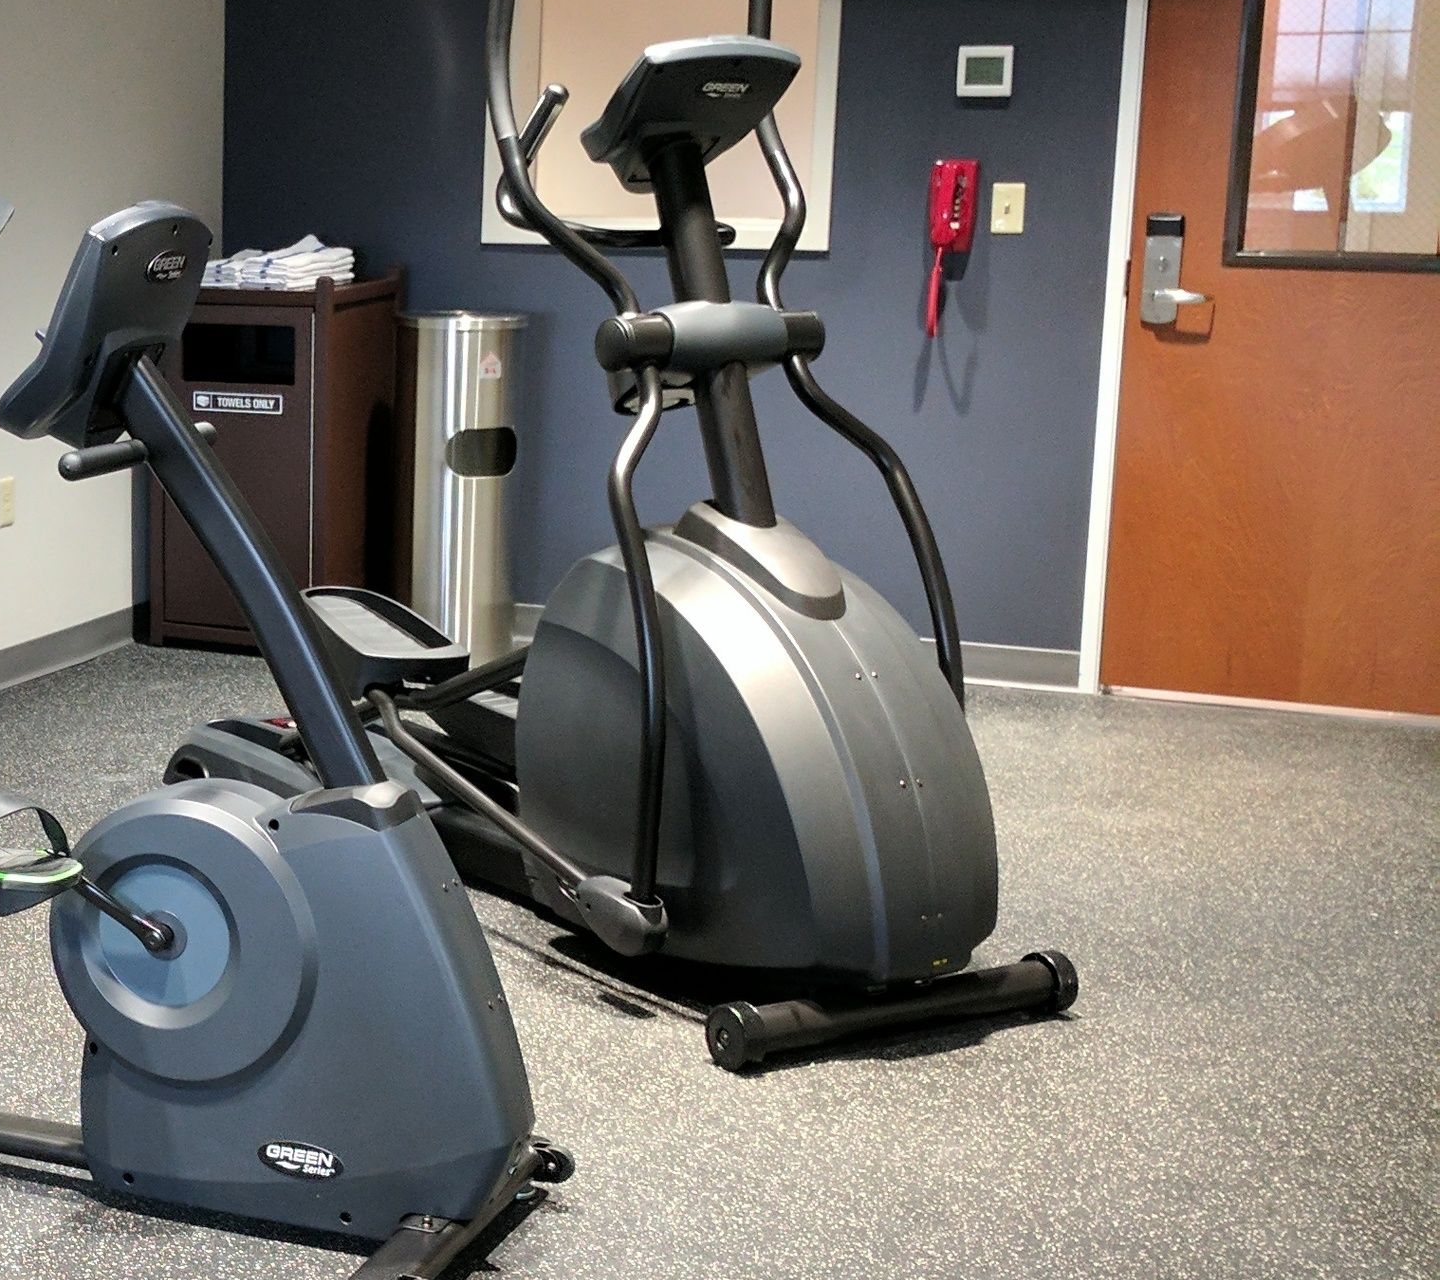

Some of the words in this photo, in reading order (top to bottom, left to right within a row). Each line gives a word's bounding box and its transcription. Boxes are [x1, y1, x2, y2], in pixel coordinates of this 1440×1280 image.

[153, 255, 186, 272] GREEN
[217, 397, 251, 409] TOWELS
[252, 398, 275, 410] ONLY
[266, 1144, 333, 1167] GREEN
